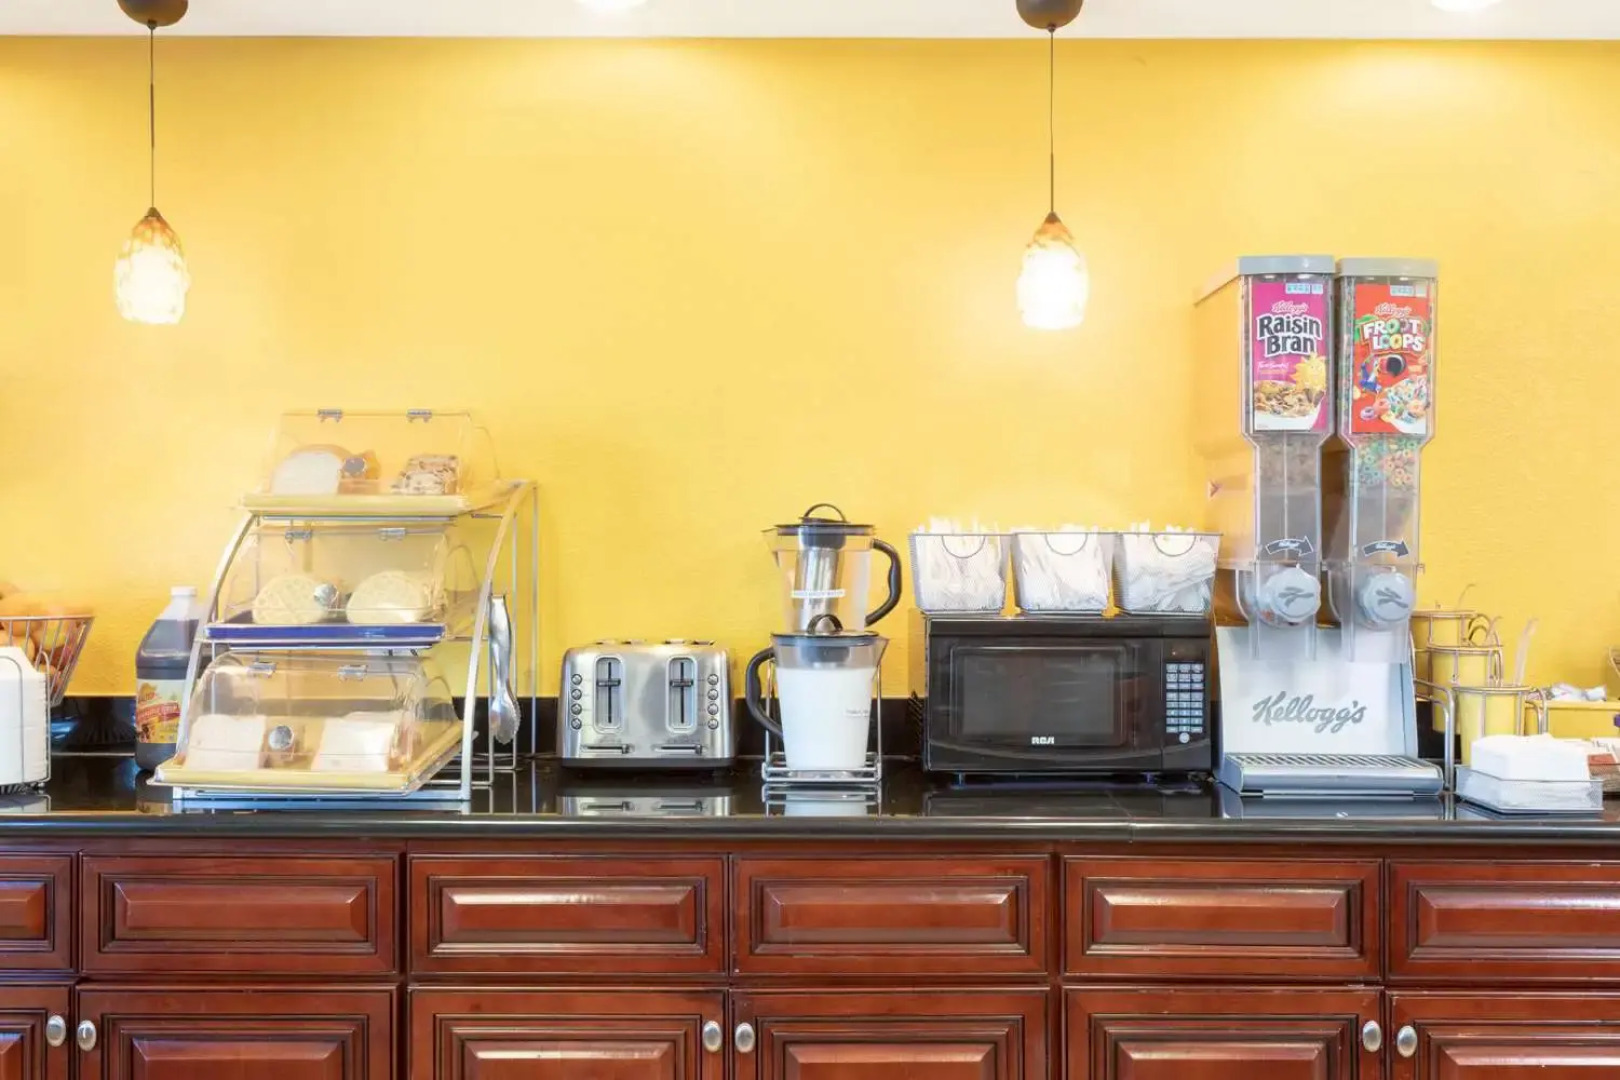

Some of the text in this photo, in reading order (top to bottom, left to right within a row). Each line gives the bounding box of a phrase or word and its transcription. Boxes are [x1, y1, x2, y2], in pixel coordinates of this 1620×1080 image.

[1257, 315, 1322, 339] Raisin
[1363, 318, 1420, 339] FROOT
[1266, 335, 1316, 355] Bran
[1372, 333, 1426, 352] LOOPS
[1252, 690, 1367, 734] Kellogg's
[1031, 736, 1055, 745] RCA
